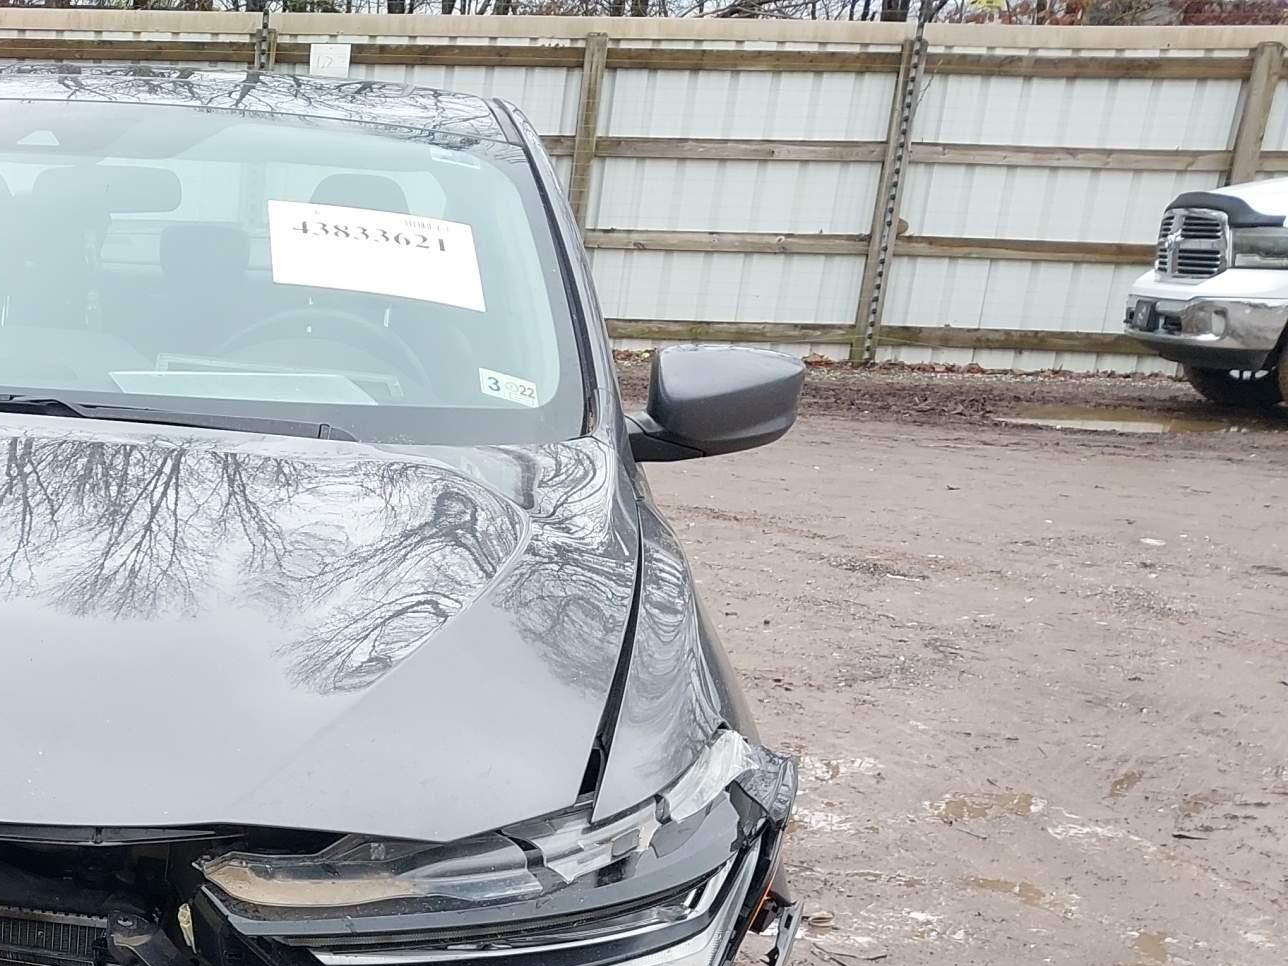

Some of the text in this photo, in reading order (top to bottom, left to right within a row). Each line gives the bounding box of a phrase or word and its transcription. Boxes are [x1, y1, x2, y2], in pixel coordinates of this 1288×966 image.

[292, 220, 446, 252] 43833621
[487, 376, 536, 400] 3 22
